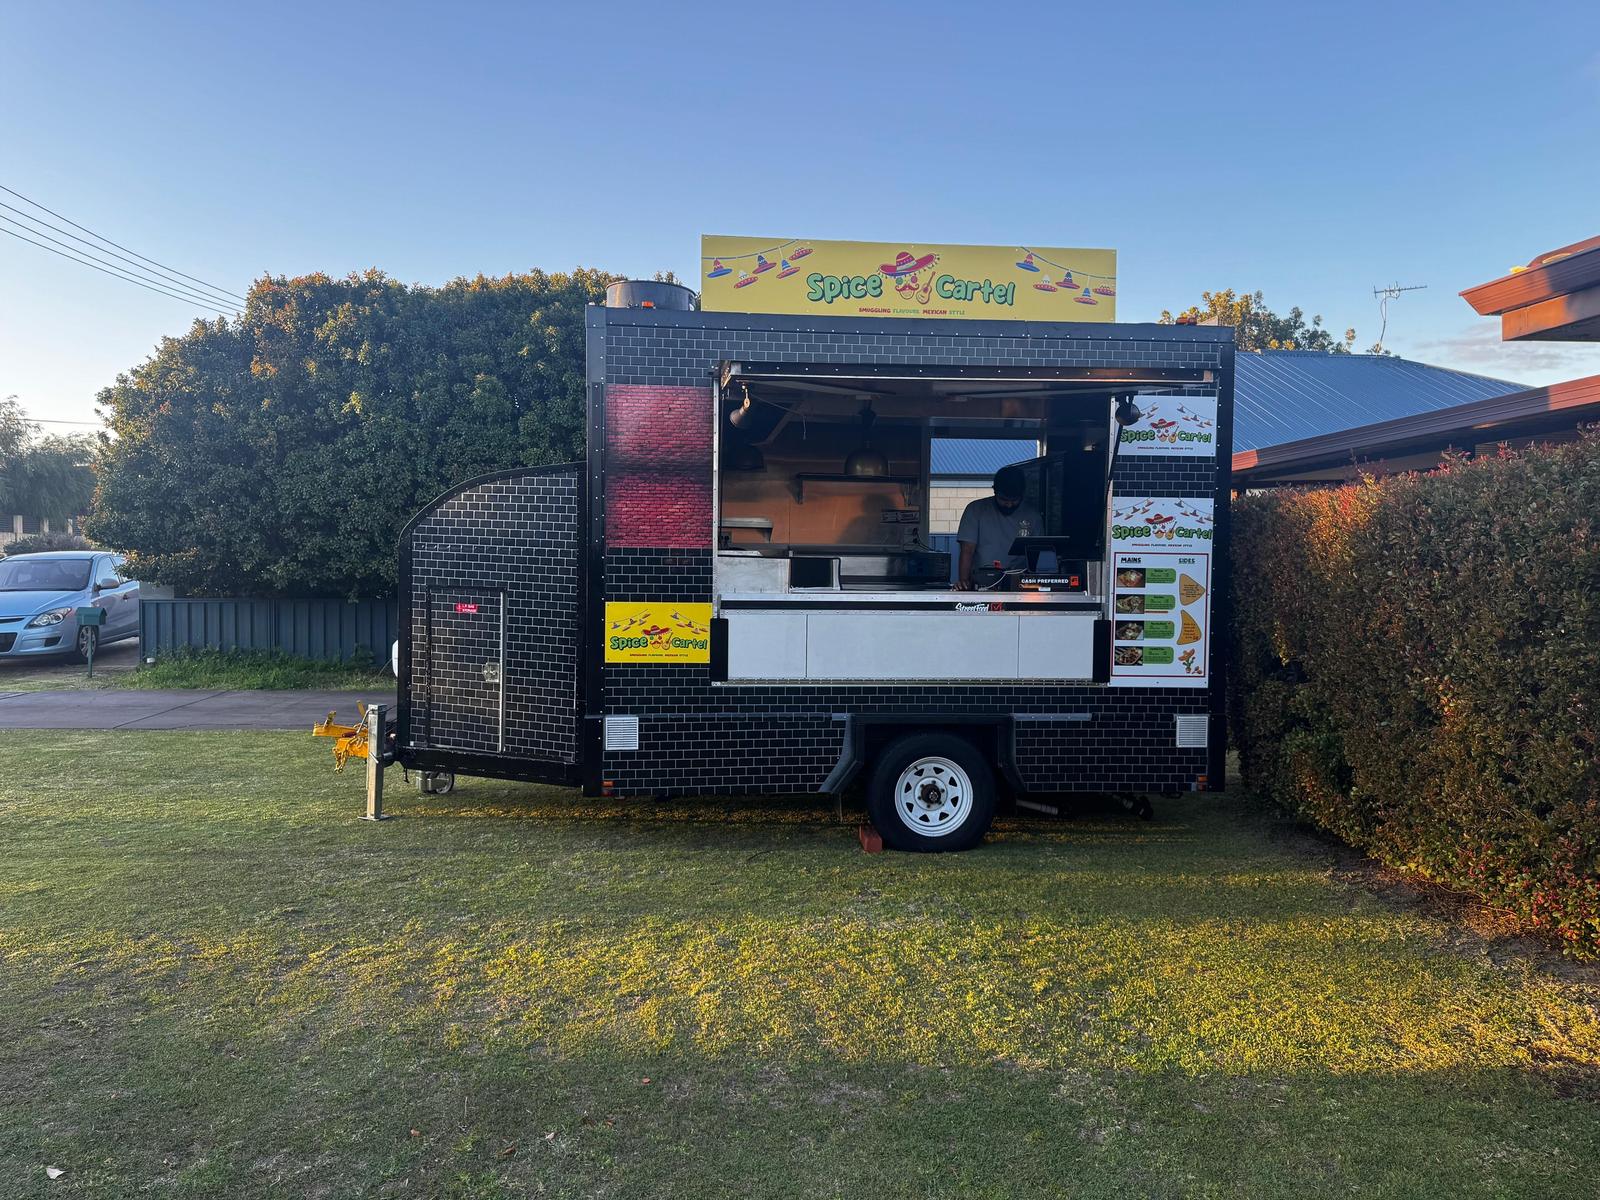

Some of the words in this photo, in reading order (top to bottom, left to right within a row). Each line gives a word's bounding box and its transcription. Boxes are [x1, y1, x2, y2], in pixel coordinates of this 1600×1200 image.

[806, 273, 883, 304] Spice
[935, 274, 1016, 306] Cartel
[1120, 428, 1155, 443] Spice
[1178, 431, 1212, 443] Cartel
[1112, 524, 1151, 540] Spice
[1175, 526, 1213, 540] Cartel
[610, 636, 648, 650] Spice
[672, 637, 708, 650] Cartel
